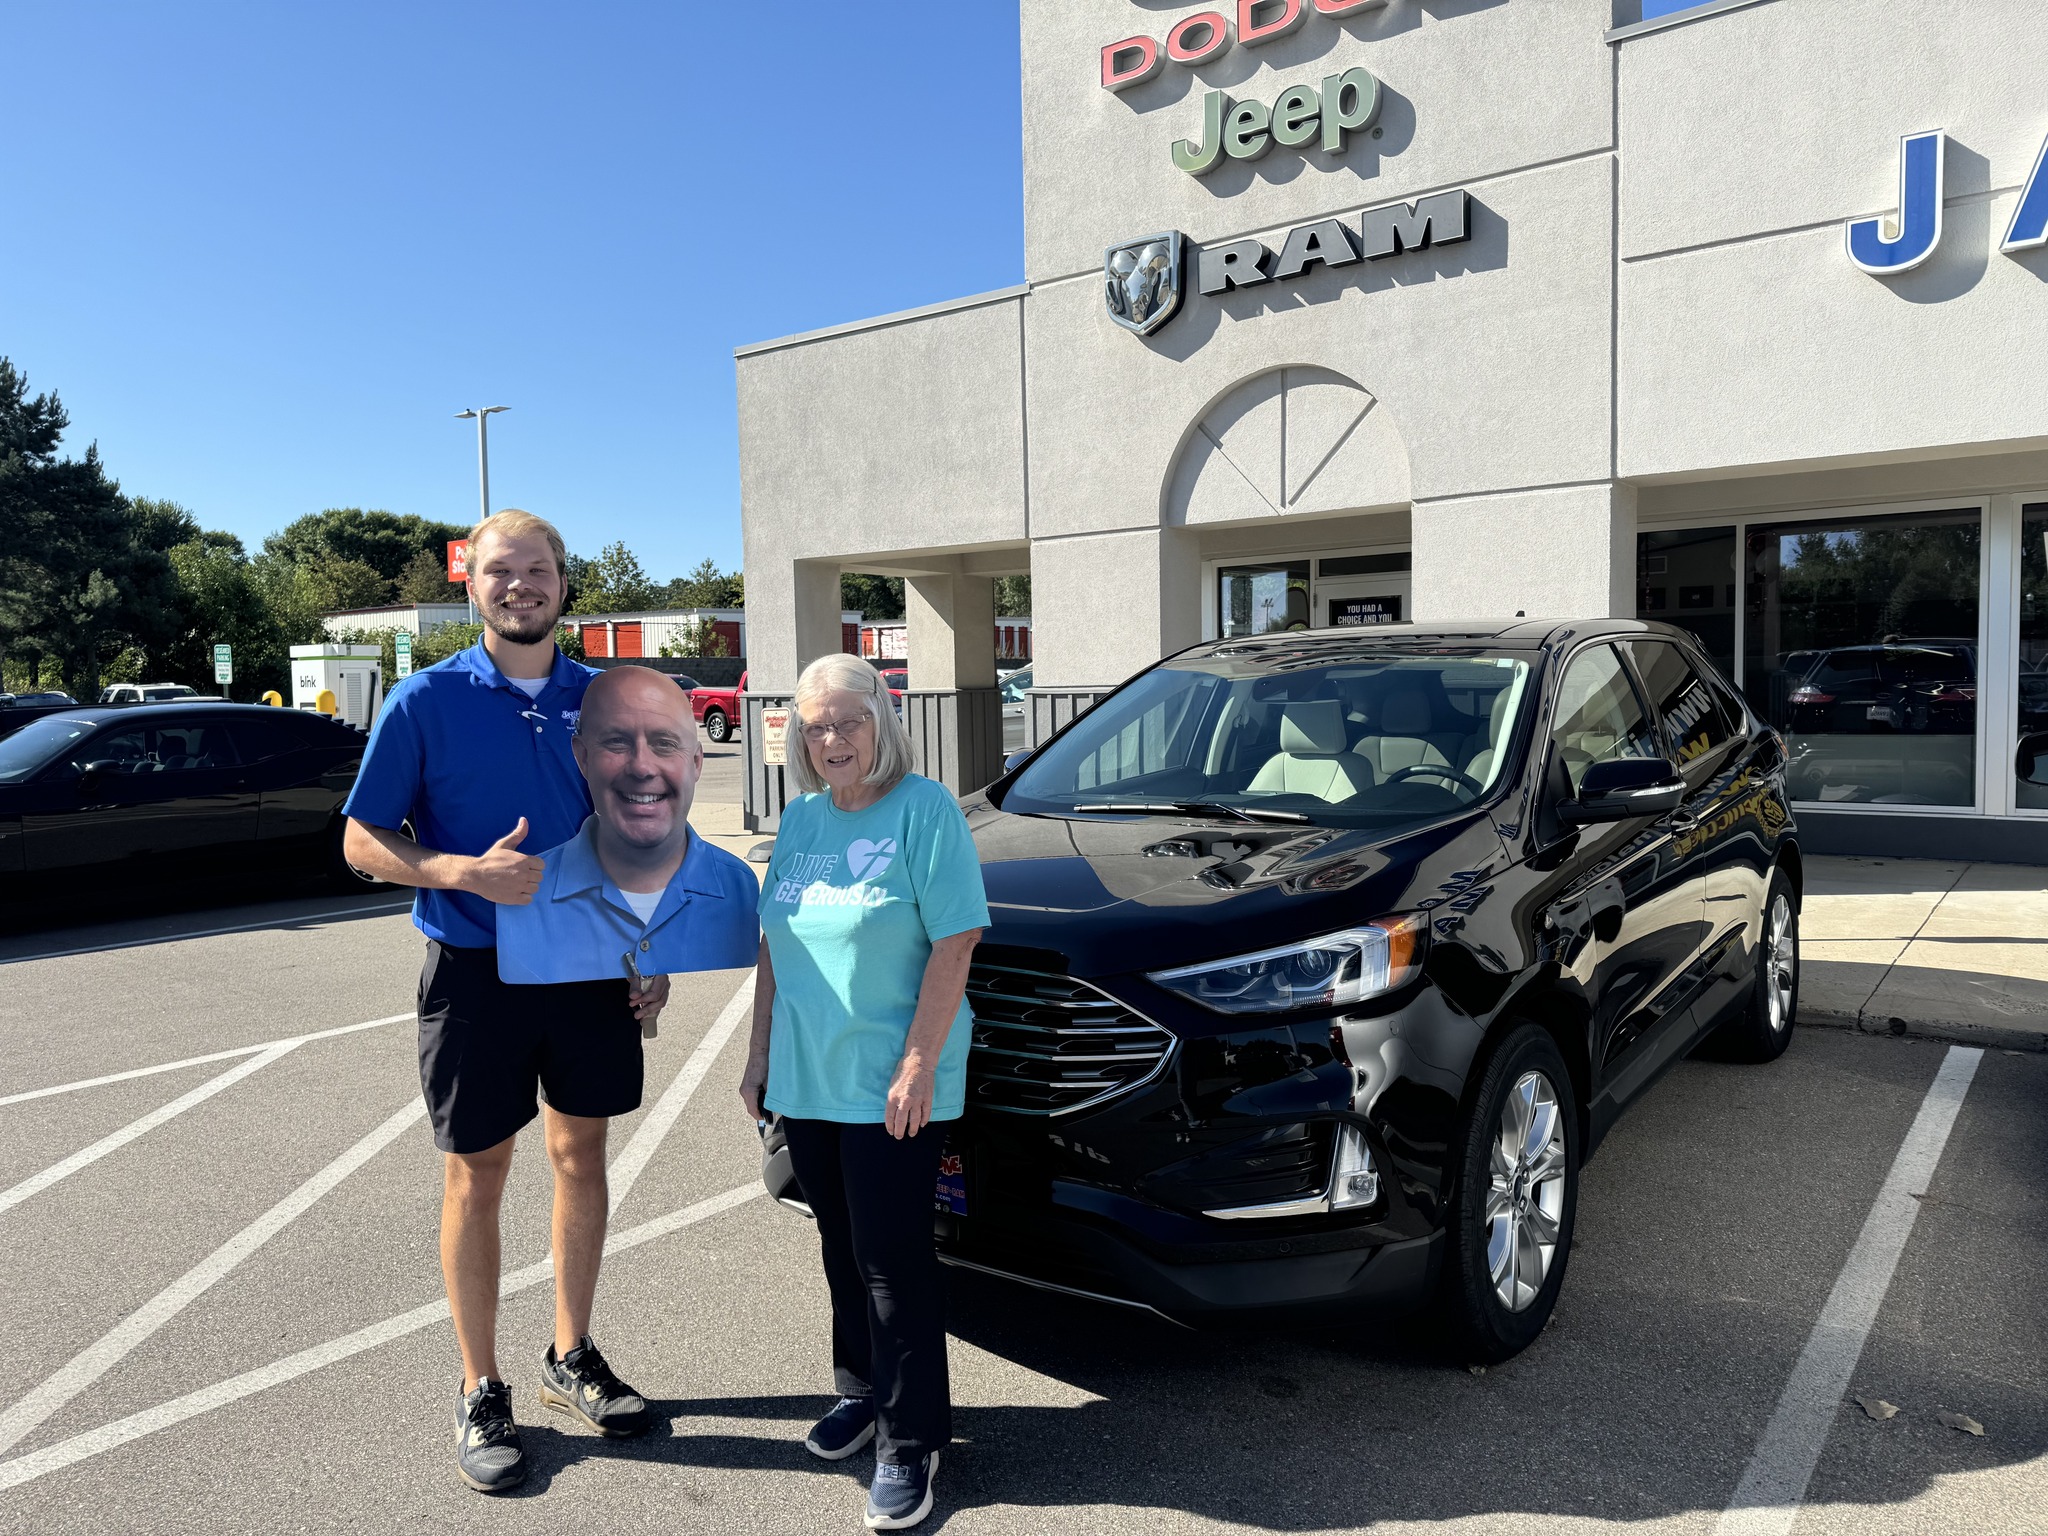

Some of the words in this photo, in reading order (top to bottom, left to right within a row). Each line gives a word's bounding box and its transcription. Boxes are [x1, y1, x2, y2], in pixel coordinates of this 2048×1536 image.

[1101, 0, 1389, 94] DOD
[1171, 66, 1383, 177] Jeep
[1198, 189, 1471, 297] RAM
[1337, 615, 1362, 625] CHOICE
[1363, 615, 1377, 624] AND
[1378, 613, 1392, 623] YOU
[1347, 605, 1360, 614] YOU
[1362, 604, 1376, 613] HAD
[1377, 604, 1382, 612] A
[300, 675, 316, 688] blink
[784, 853, 839, 885] LIVE
[775, 880, 888, 906] GENEROUSLY
